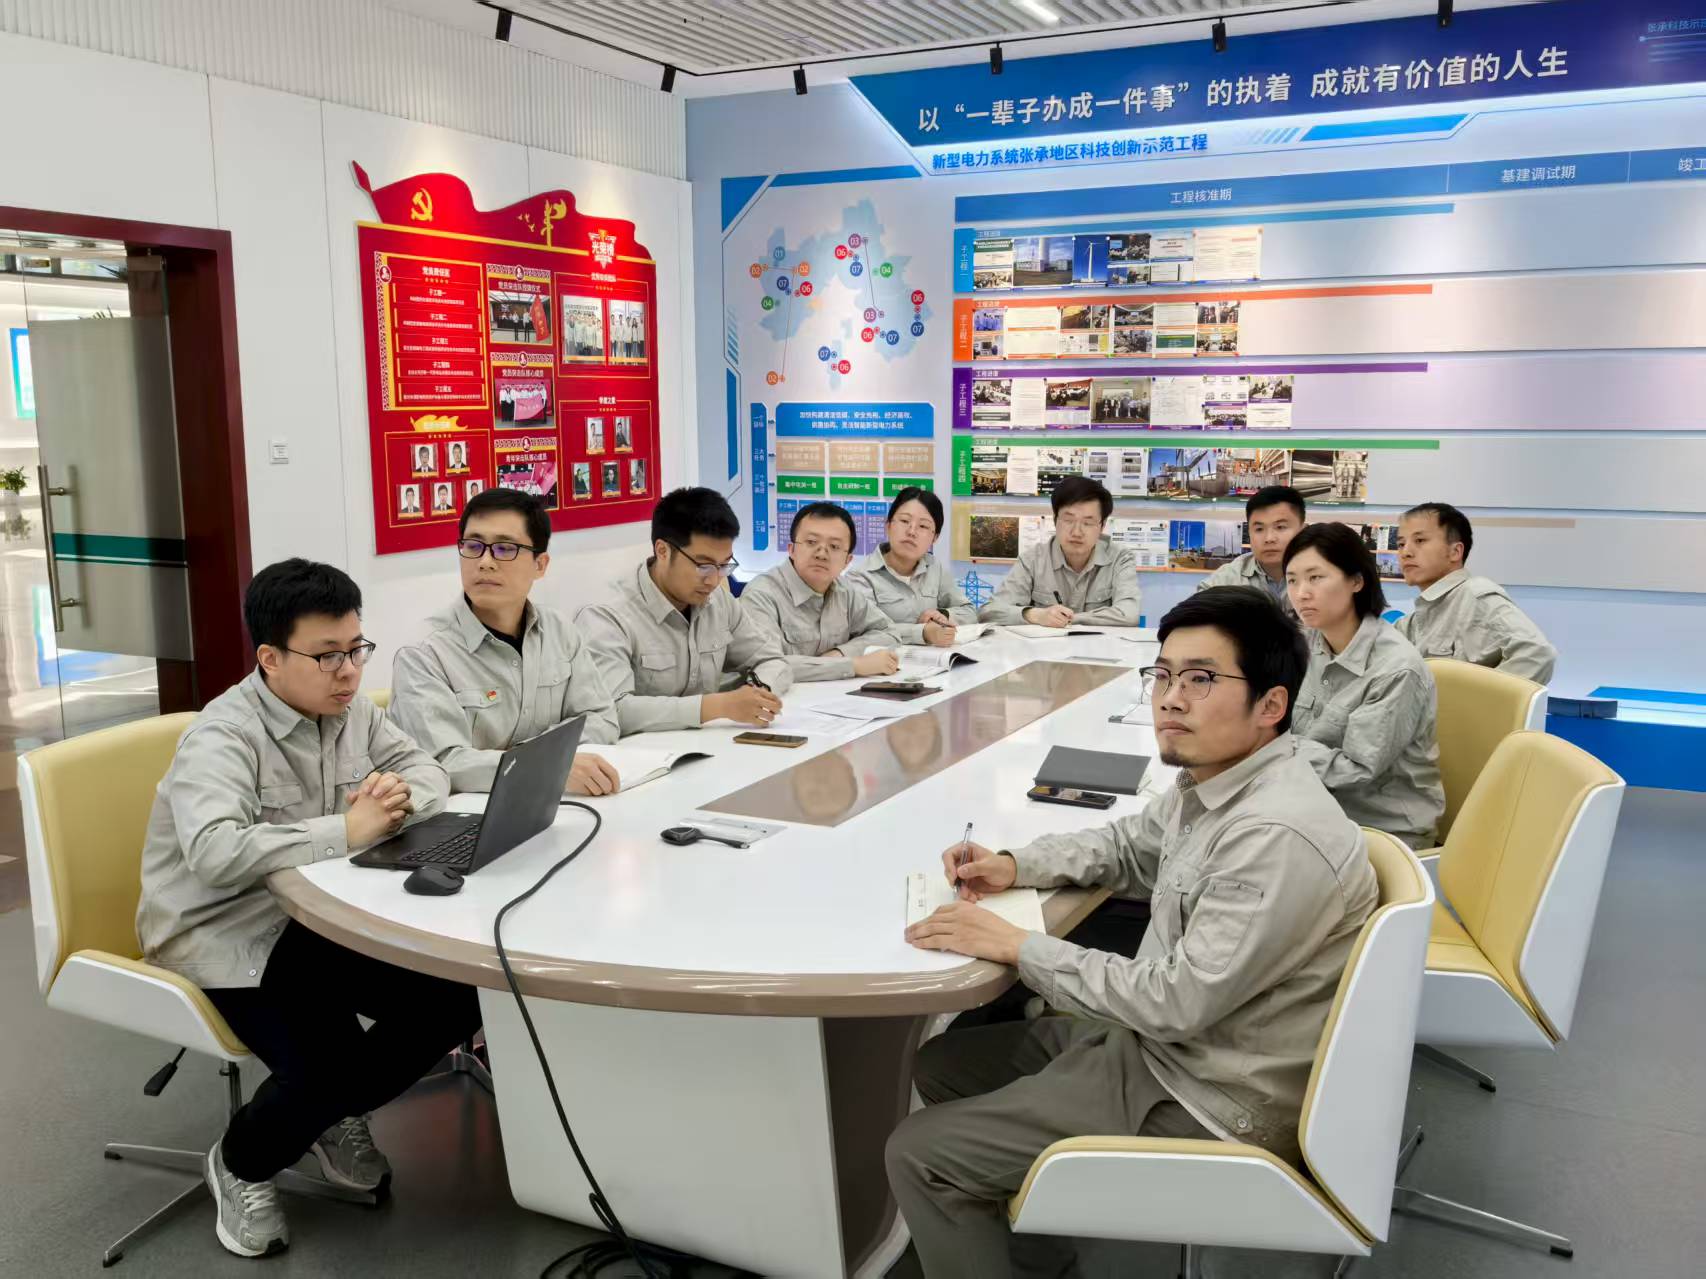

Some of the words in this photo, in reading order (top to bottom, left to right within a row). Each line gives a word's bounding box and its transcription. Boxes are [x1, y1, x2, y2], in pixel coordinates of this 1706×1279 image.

[1311, 46, 1569, 99] 成就有价值的人生
[932, 134, 1208, 169] 新型电力系统张承地区科技创新示范工程
[1501, 164, 1576, 184] 基建调试期
[1170, 187, 1232, 204] 工程核准期
[852, 265, 861, 273] 07
[778, 280, 787, 288] 07
[802, 285, 810, 293] 06
[863, 331, 872, 339] 06
[820, 350, 829, 358] 07
